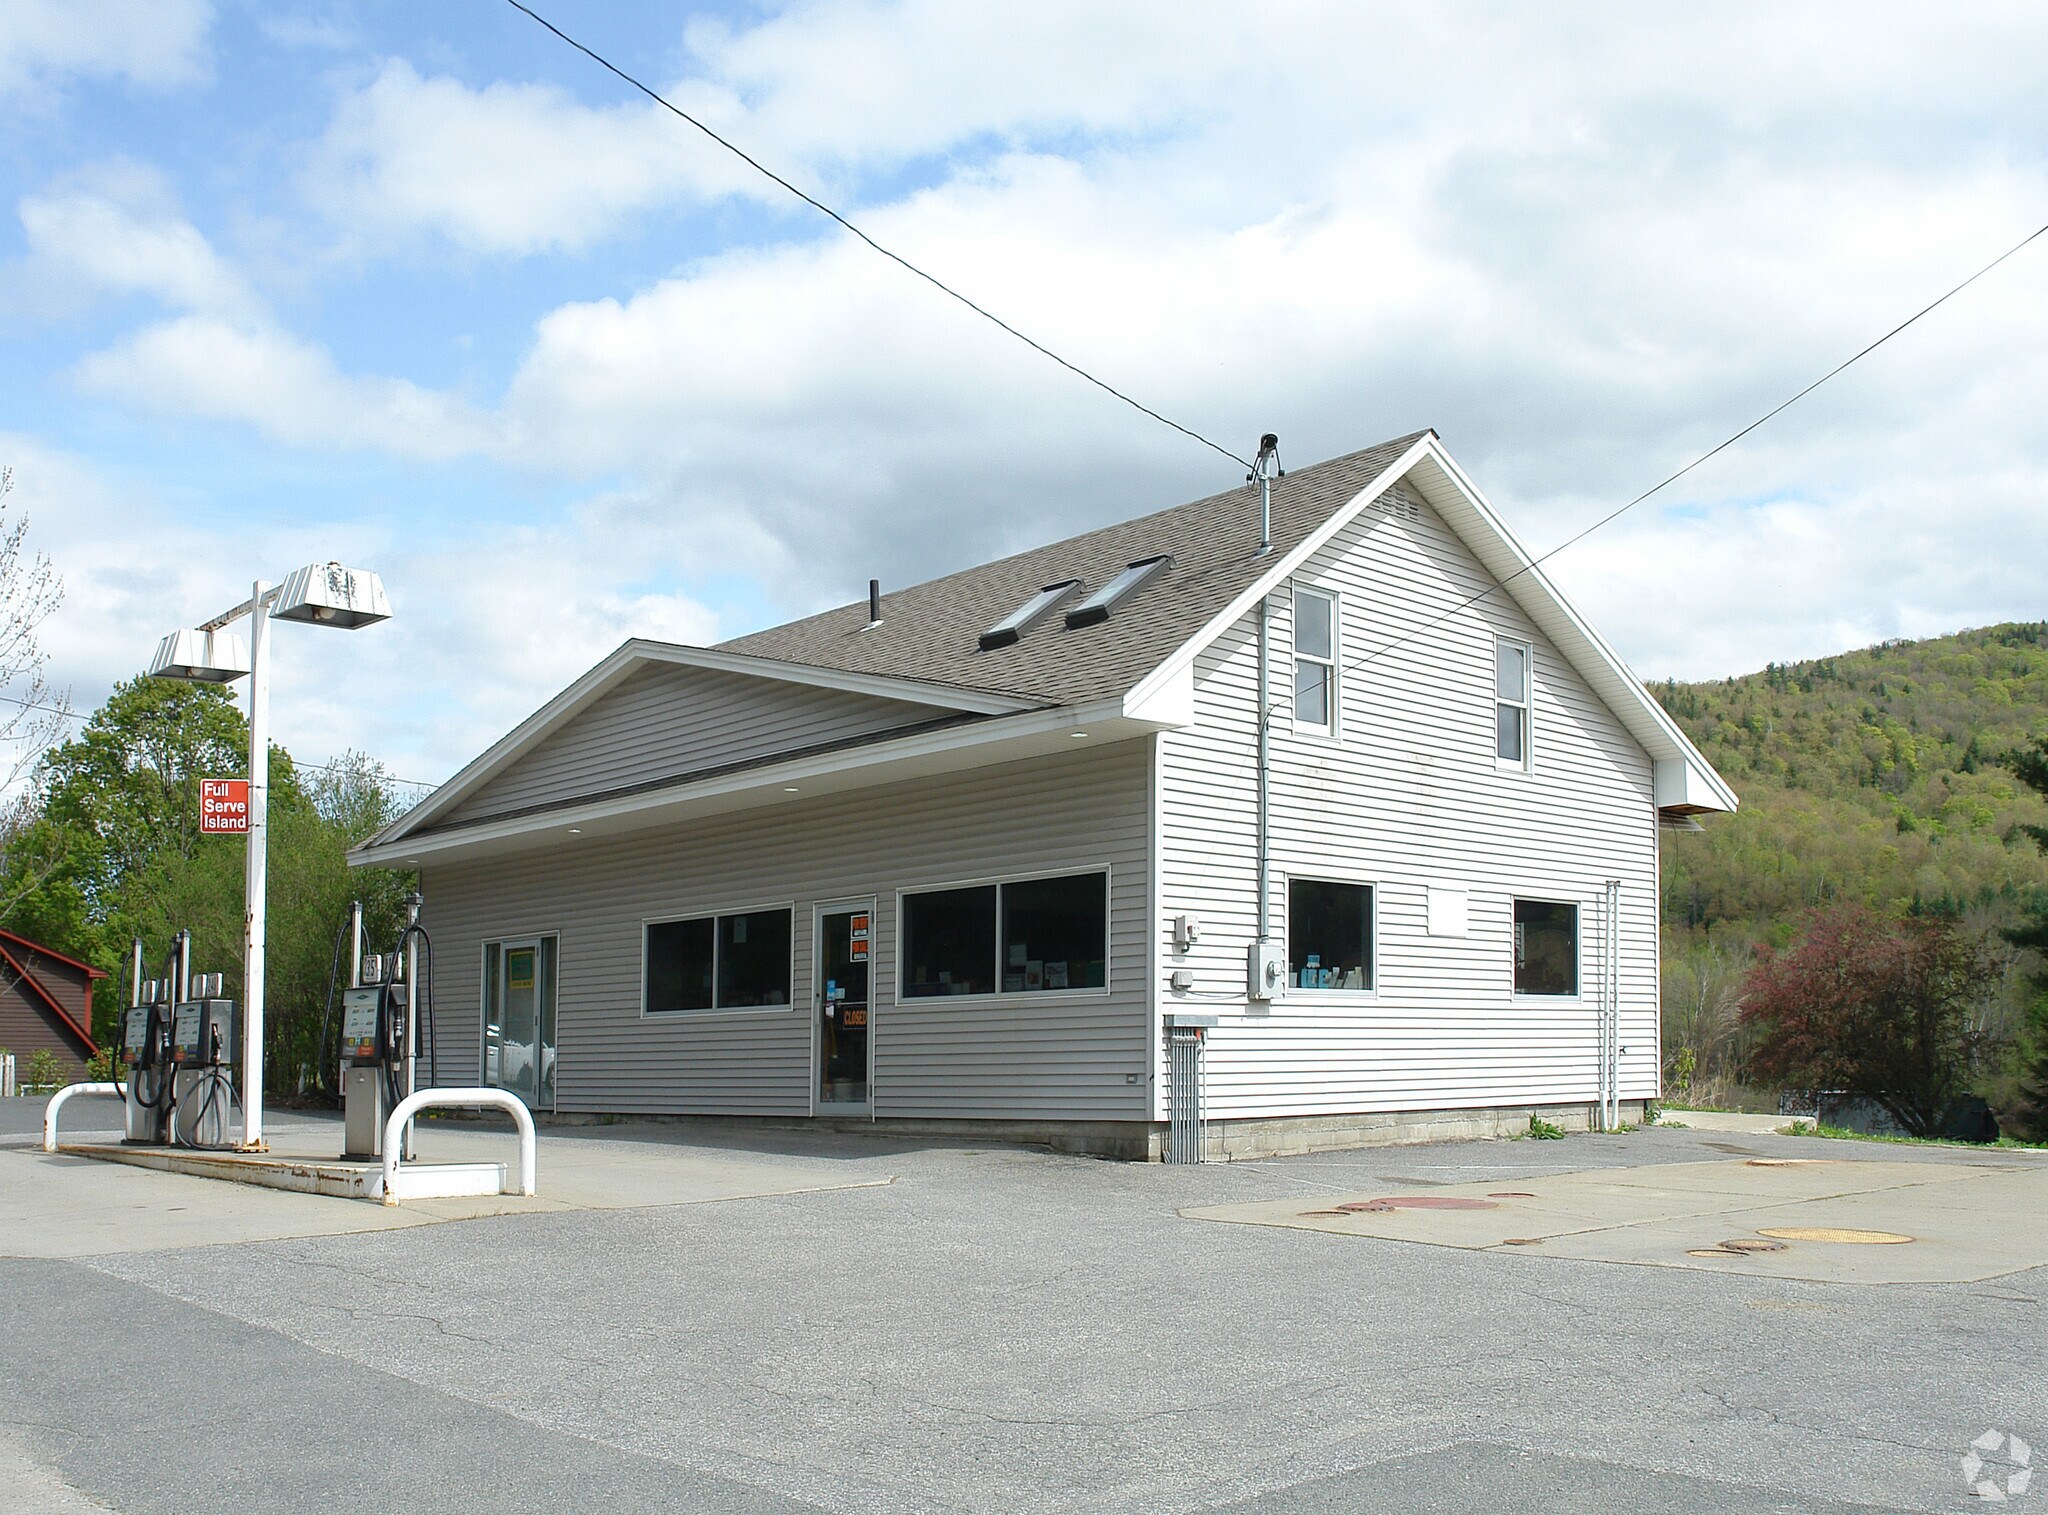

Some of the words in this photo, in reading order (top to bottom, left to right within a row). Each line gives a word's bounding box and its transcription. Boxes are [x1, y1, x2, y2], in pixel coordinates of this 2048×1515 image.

[204, 782, 229, 797] Full
[204, 798, 246, 813] Serve
[204, 815, 246, 829] Island
[844, 1010, 867, 1026] CLOSED
